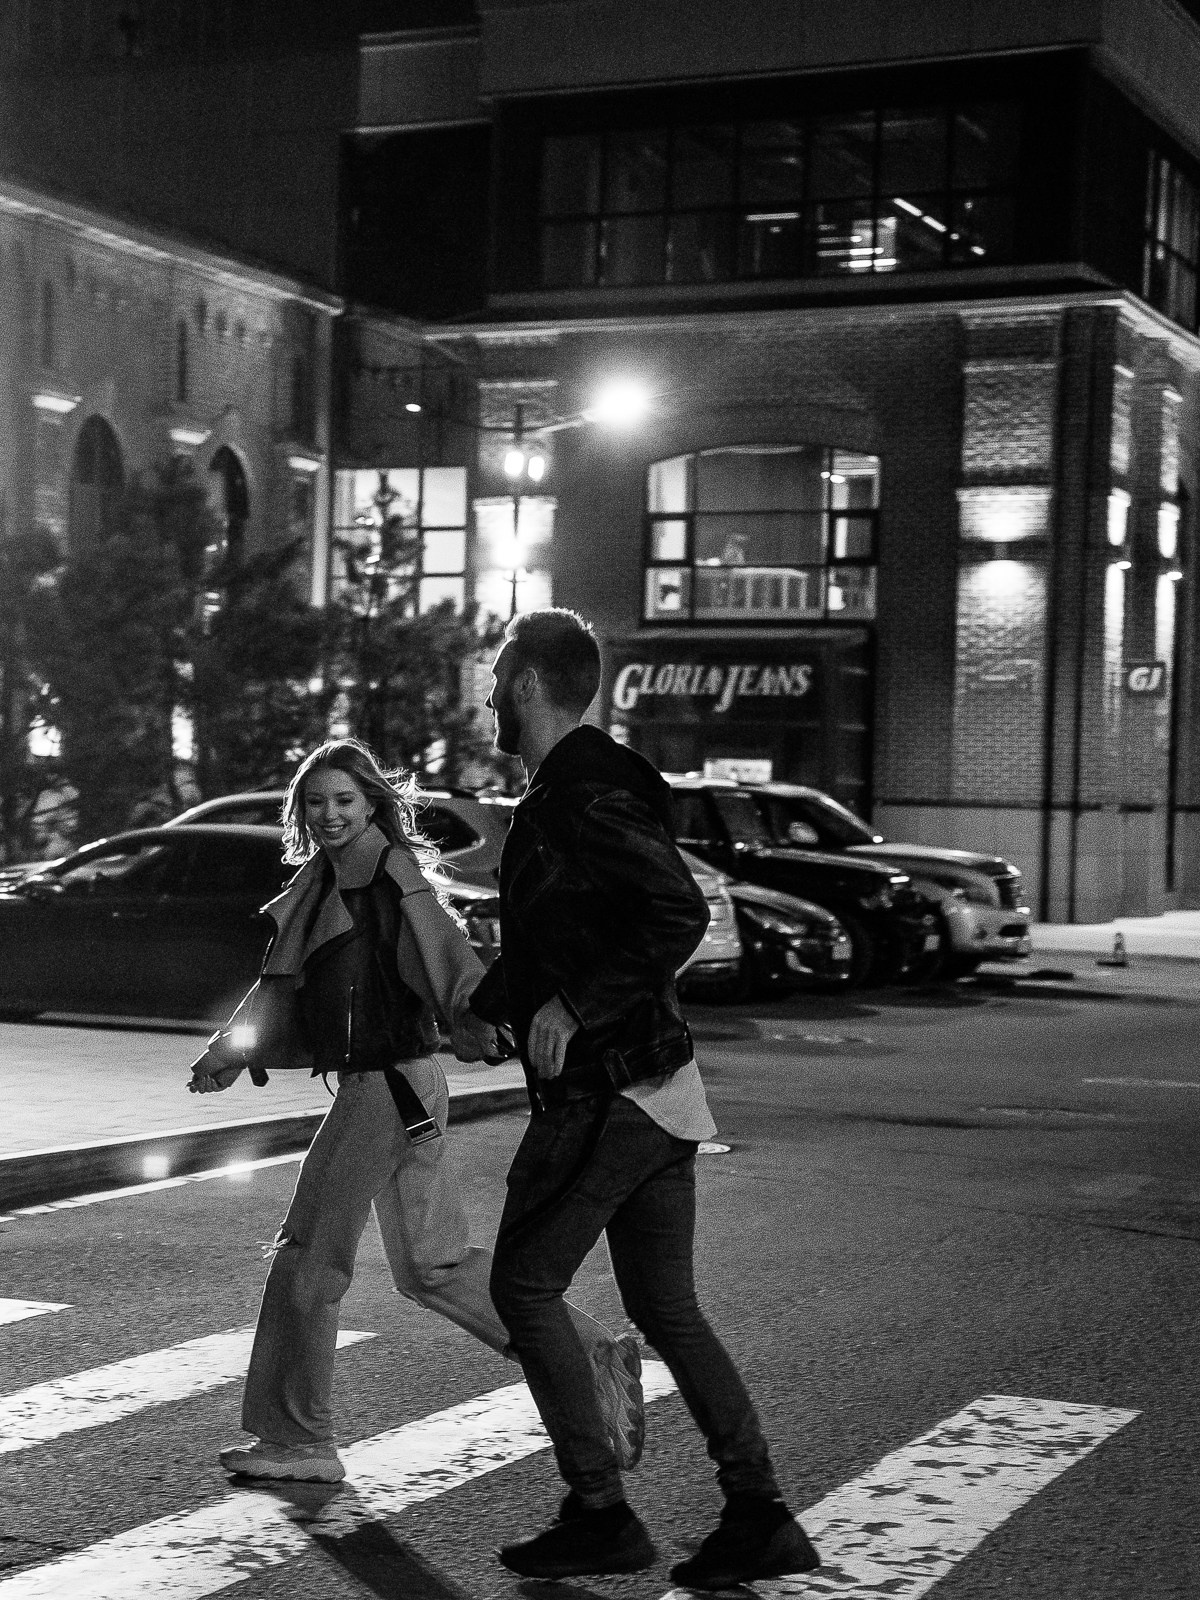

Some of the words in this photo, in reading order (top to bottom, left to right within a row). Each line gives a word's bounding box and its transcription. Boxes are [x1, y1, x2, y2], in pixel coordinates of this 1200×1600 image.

[612, 663, 722, 710] GLORIA
[714, 664, 813, 713] JEANS
[1128, 666, 1162, 691] GJ
